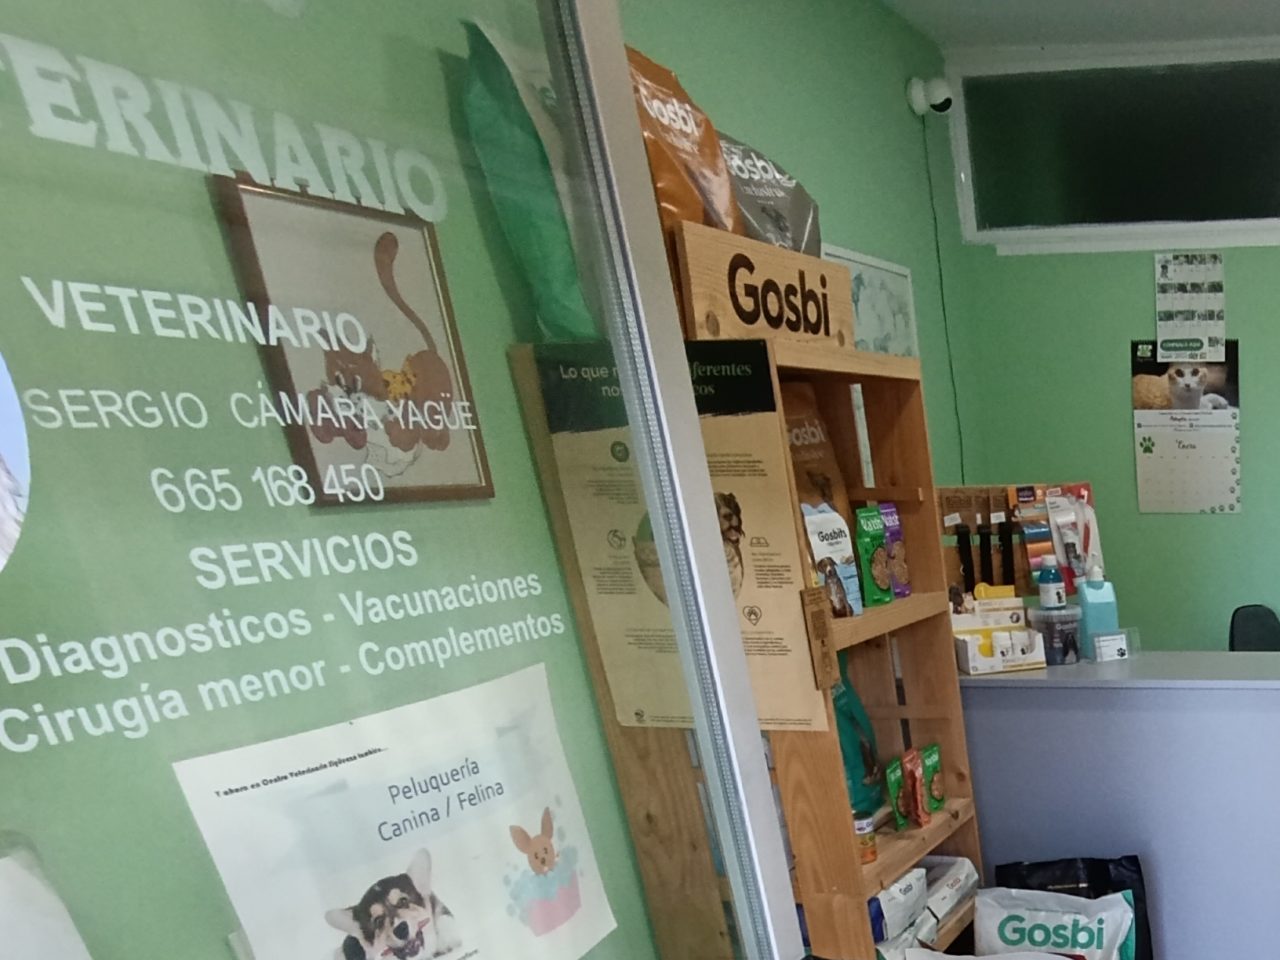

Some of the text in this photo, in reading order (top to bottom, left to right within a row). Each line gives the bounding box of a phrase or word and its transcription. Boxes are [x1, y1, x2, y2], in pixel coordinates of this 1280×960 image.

[0, 33, 448, 223] ERINARIO
[21, 276, 368, 354] VETERINARIO
[727, 253, 831, 337] Gosbi
[560, 364, 577, 379] Lo
[581, 366, 609, 381] que
[690, 362, 752, 380] ferentes
[23, 381, 477, 431] SERGIO CÁMARA YAGÜE
[150, 463, 385, 513] 665 168 450
[188, 530, 419, 590] SERVICIOS
[1, 603, 312, 685] Diagnosticos
[339, 570, 543, 628] Vacunaciones
[0, 684, 188, 753] Cirugía
[197, 660, 327, 712] menor
[358, 609, 565, 677] Complementos
[377, 805, 441, 842] Canina
[457, 780, 505, 811] Felina
[387, 758, 480, 805] Peluquería
[998, 914, 1105, 950] Gosbi
